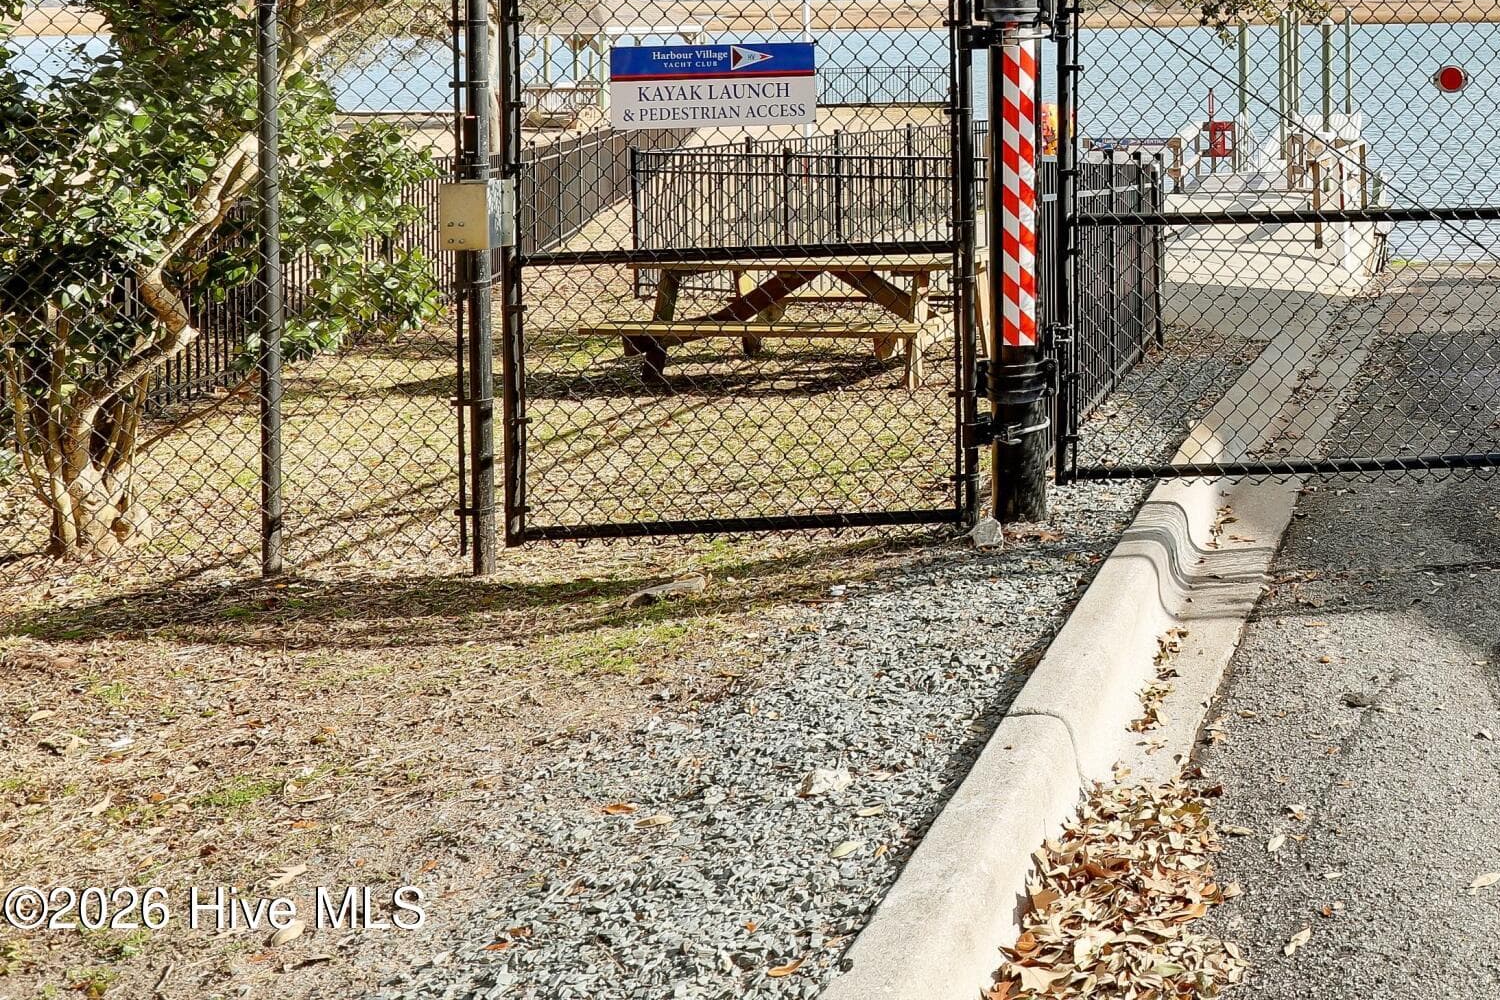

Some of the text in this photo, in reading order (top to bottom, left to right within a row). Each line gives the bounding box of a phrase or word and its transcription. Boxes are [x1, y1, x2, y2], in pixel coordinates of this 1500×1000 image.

[652, 50, 728, 60] Harbour Village
[638, 82, 790, 102] KAYAK LAUNCH
[624, 103, 806, 121] & PEDESTRIAN ACCESS
